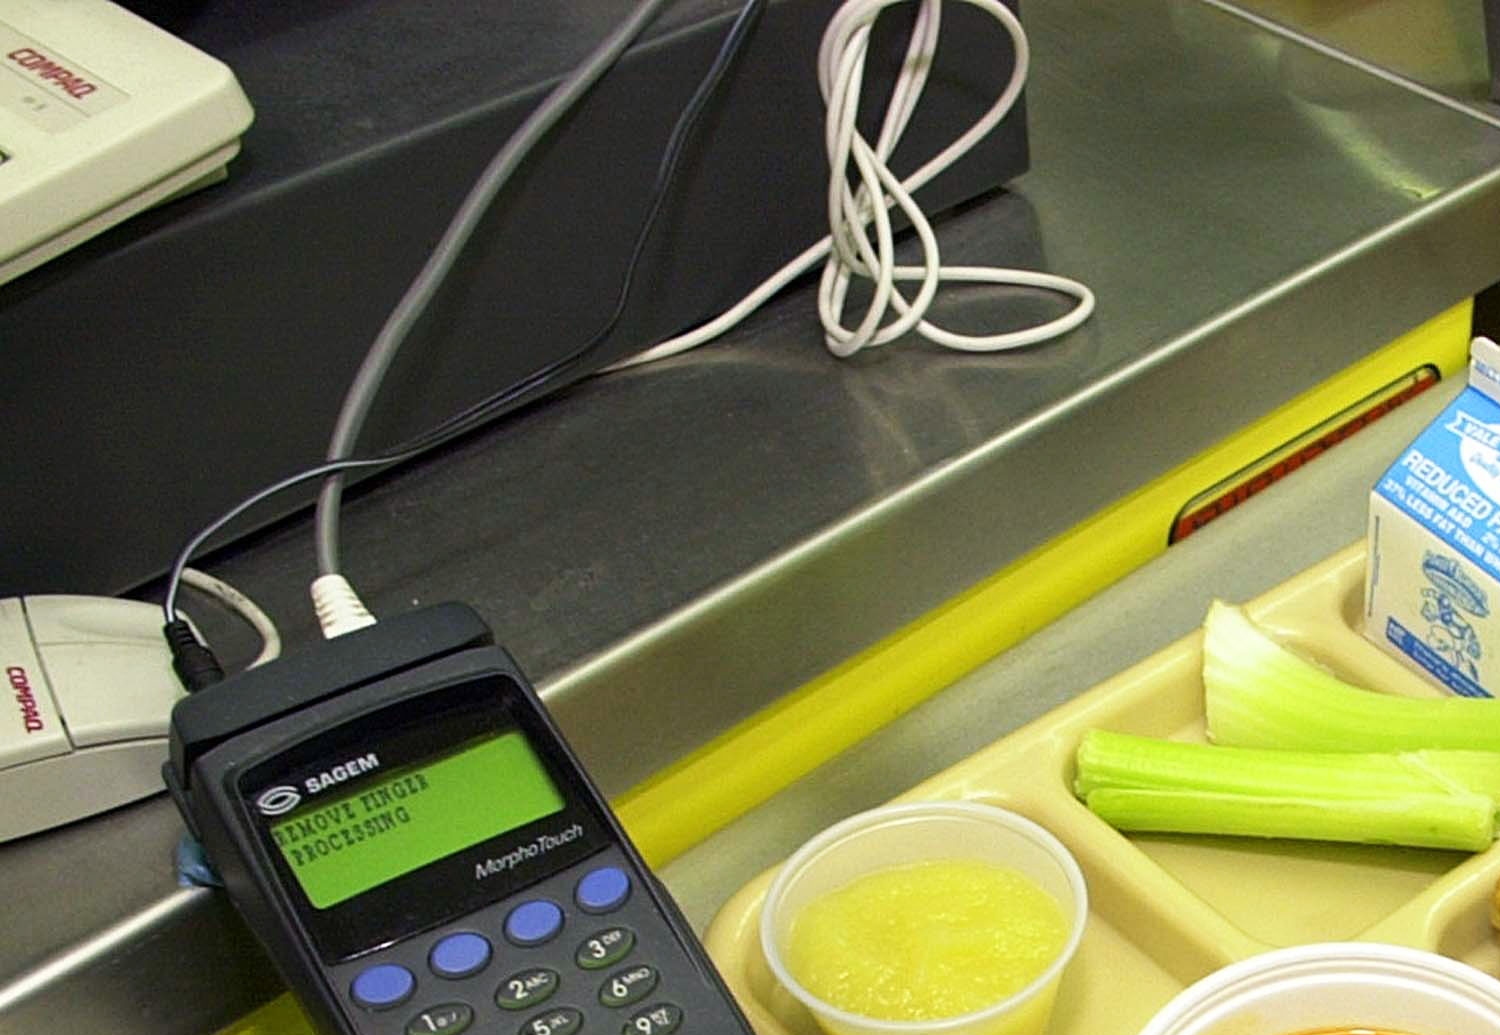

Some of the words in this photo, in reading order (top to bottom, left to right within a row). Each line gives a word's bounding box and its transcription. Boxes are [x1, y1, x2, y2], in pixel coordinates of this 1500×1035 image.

[7, 48, 98, 99] COMPAQ
[1401, 449, 1494, 519] REDUCED
[6, 667, 44, 734] COMPAQ
[305, 753, 379, 794] SAGEM
[360, 774, 428, 812] FINGER
[291, 806, 411, 867] PROCESSING
[475, 824, 583, 880] MorphoTouch
[586, 939, 606, 959] 3
[509, 980, 528, 999] 2
[612, 978, 628, 998] 6
[421, 1014, 437, 1032] 1
[636, 1017, 652, 1035] 9
